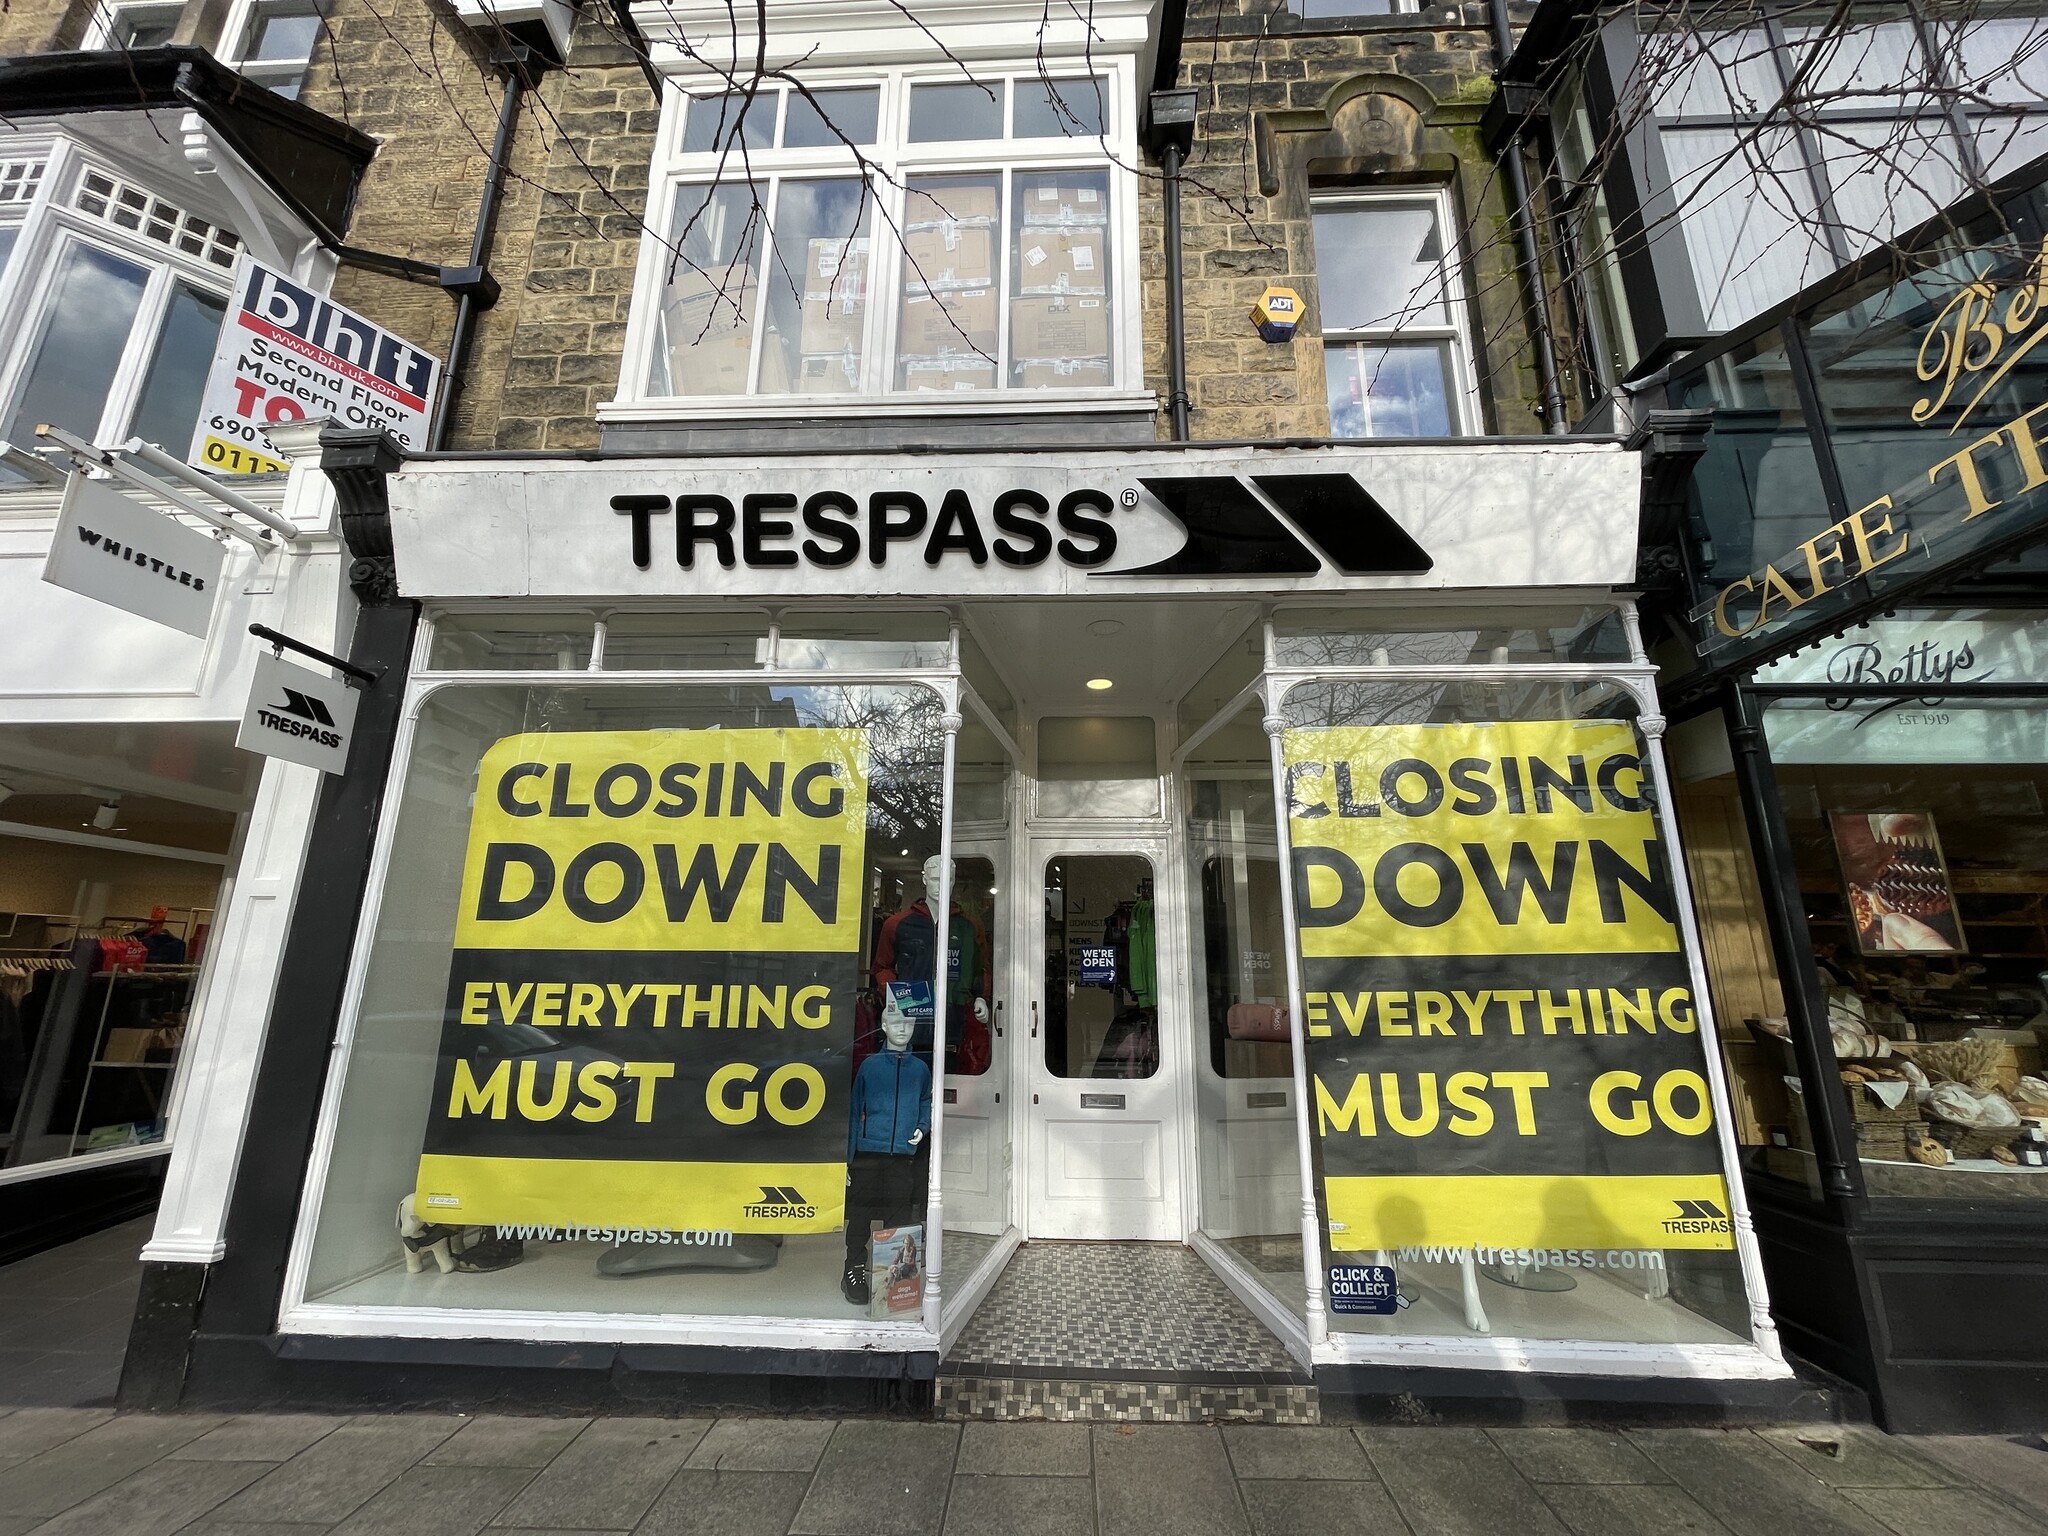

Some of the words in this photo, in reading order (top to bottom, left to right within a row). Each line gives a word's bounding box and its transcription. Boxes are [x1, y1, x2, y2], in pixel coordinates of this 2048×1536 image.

[1048, 304, 1071, 313] DLX
[1270, 298, 1293, 310] ADT
[254, 272, 418, 392] bht
[237, 354, 338, 413] Modern
[250, 338, 343, 393] Second
[351, 386, 409, 424] Floor
[271, 330, 399, 400] www.bht.uk.com
[234, 376, 306, 422] TO
[210, 415, 256, 442] 690
[78, 525, 205, 592] WHISTLES
[1713, 493, 1910, 638] CAFE
[1825, 640, 1995, 711] Bettys
[257, 709, 341, 749] TRESPASS
[1897, 714, 1919, 725] EST
[1923, 714, 1950, 725] 1919
[496, 761, 845, 819] CLOSING
[1286, 754, 1654, 819] CLOSING
[475, 841, 842, 925] DOWN
[1292, 839, 1675, 928] DOWN
[1069, 937, 1092, 945] MENS
[1082, 949, 1114, 958] WE'RE
[1083, 958, 1114, 967] OPEN
[460, 981, 832, 1030] EVERYTHING
[1308, 987, 1696, 1037] EVERYTHING
[447, 1058, 675, 1124] MUST
[705, 1062, 827, 1126] GO
[1314, 1070, 1550, 1137] MUST
[1589, 1068, 1714, 1137] GO
[743, 1205, 816, 1219] TRESPASS
[1661, 1219, 1735, 1234] TRESPASS
[495, 1220, 734, 1248] www.trespass.com
[1331, 1268, 1370, 1282] CLICK
[1373, 1267, 1385, 1282] &
[1399, 1242, 1665, 1273] www.trespass.com
[891, 1291, 918, 1300] welcome!
[897, 1286, 911, 1294] dogs
[1332, 1282, 1390, 1296] COLLECT
